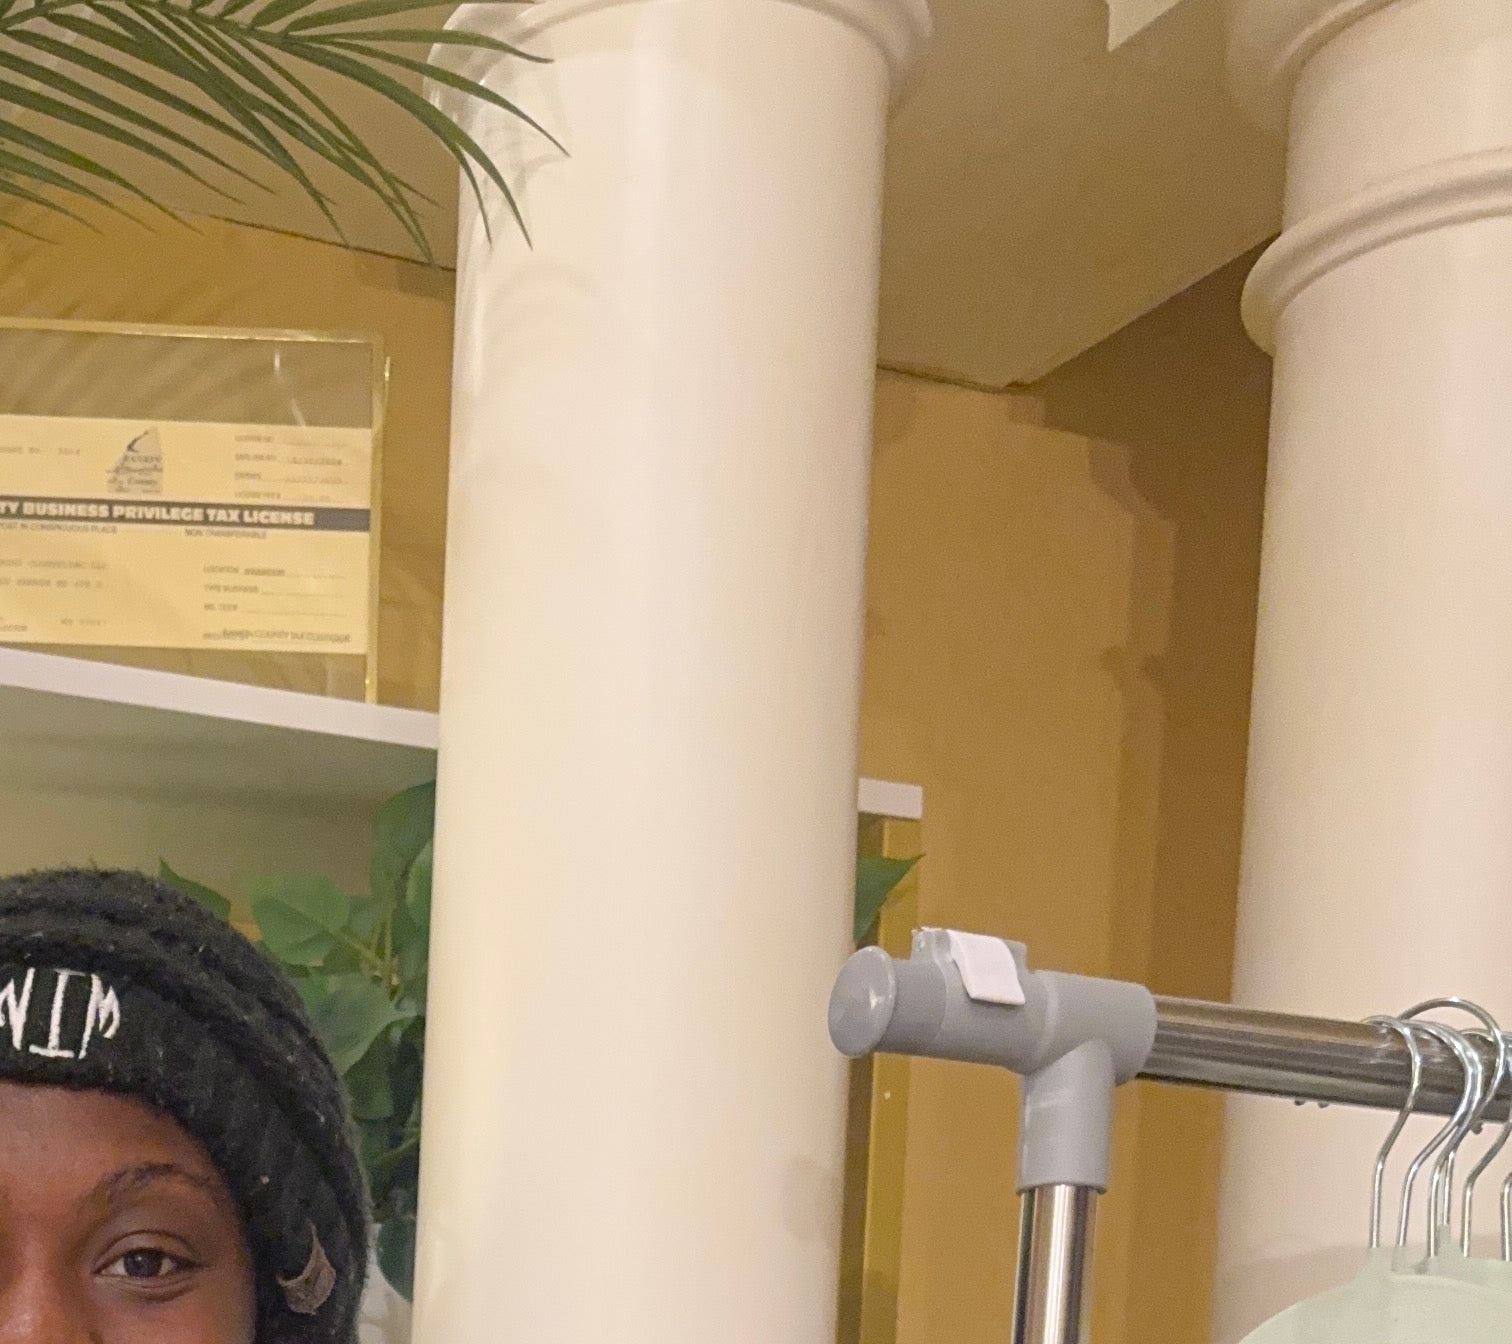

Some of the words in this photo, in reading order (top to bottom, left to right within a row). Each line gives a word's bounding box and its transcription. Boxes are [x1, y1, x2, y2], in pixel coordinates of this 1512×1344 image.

[23, 501, 109, 518] BUSINESS
[112, 504, 204, 522] PRIVILEGE
[206, 508, 240, 523] TAX
[243, 510, 315, 526] LICENSE
